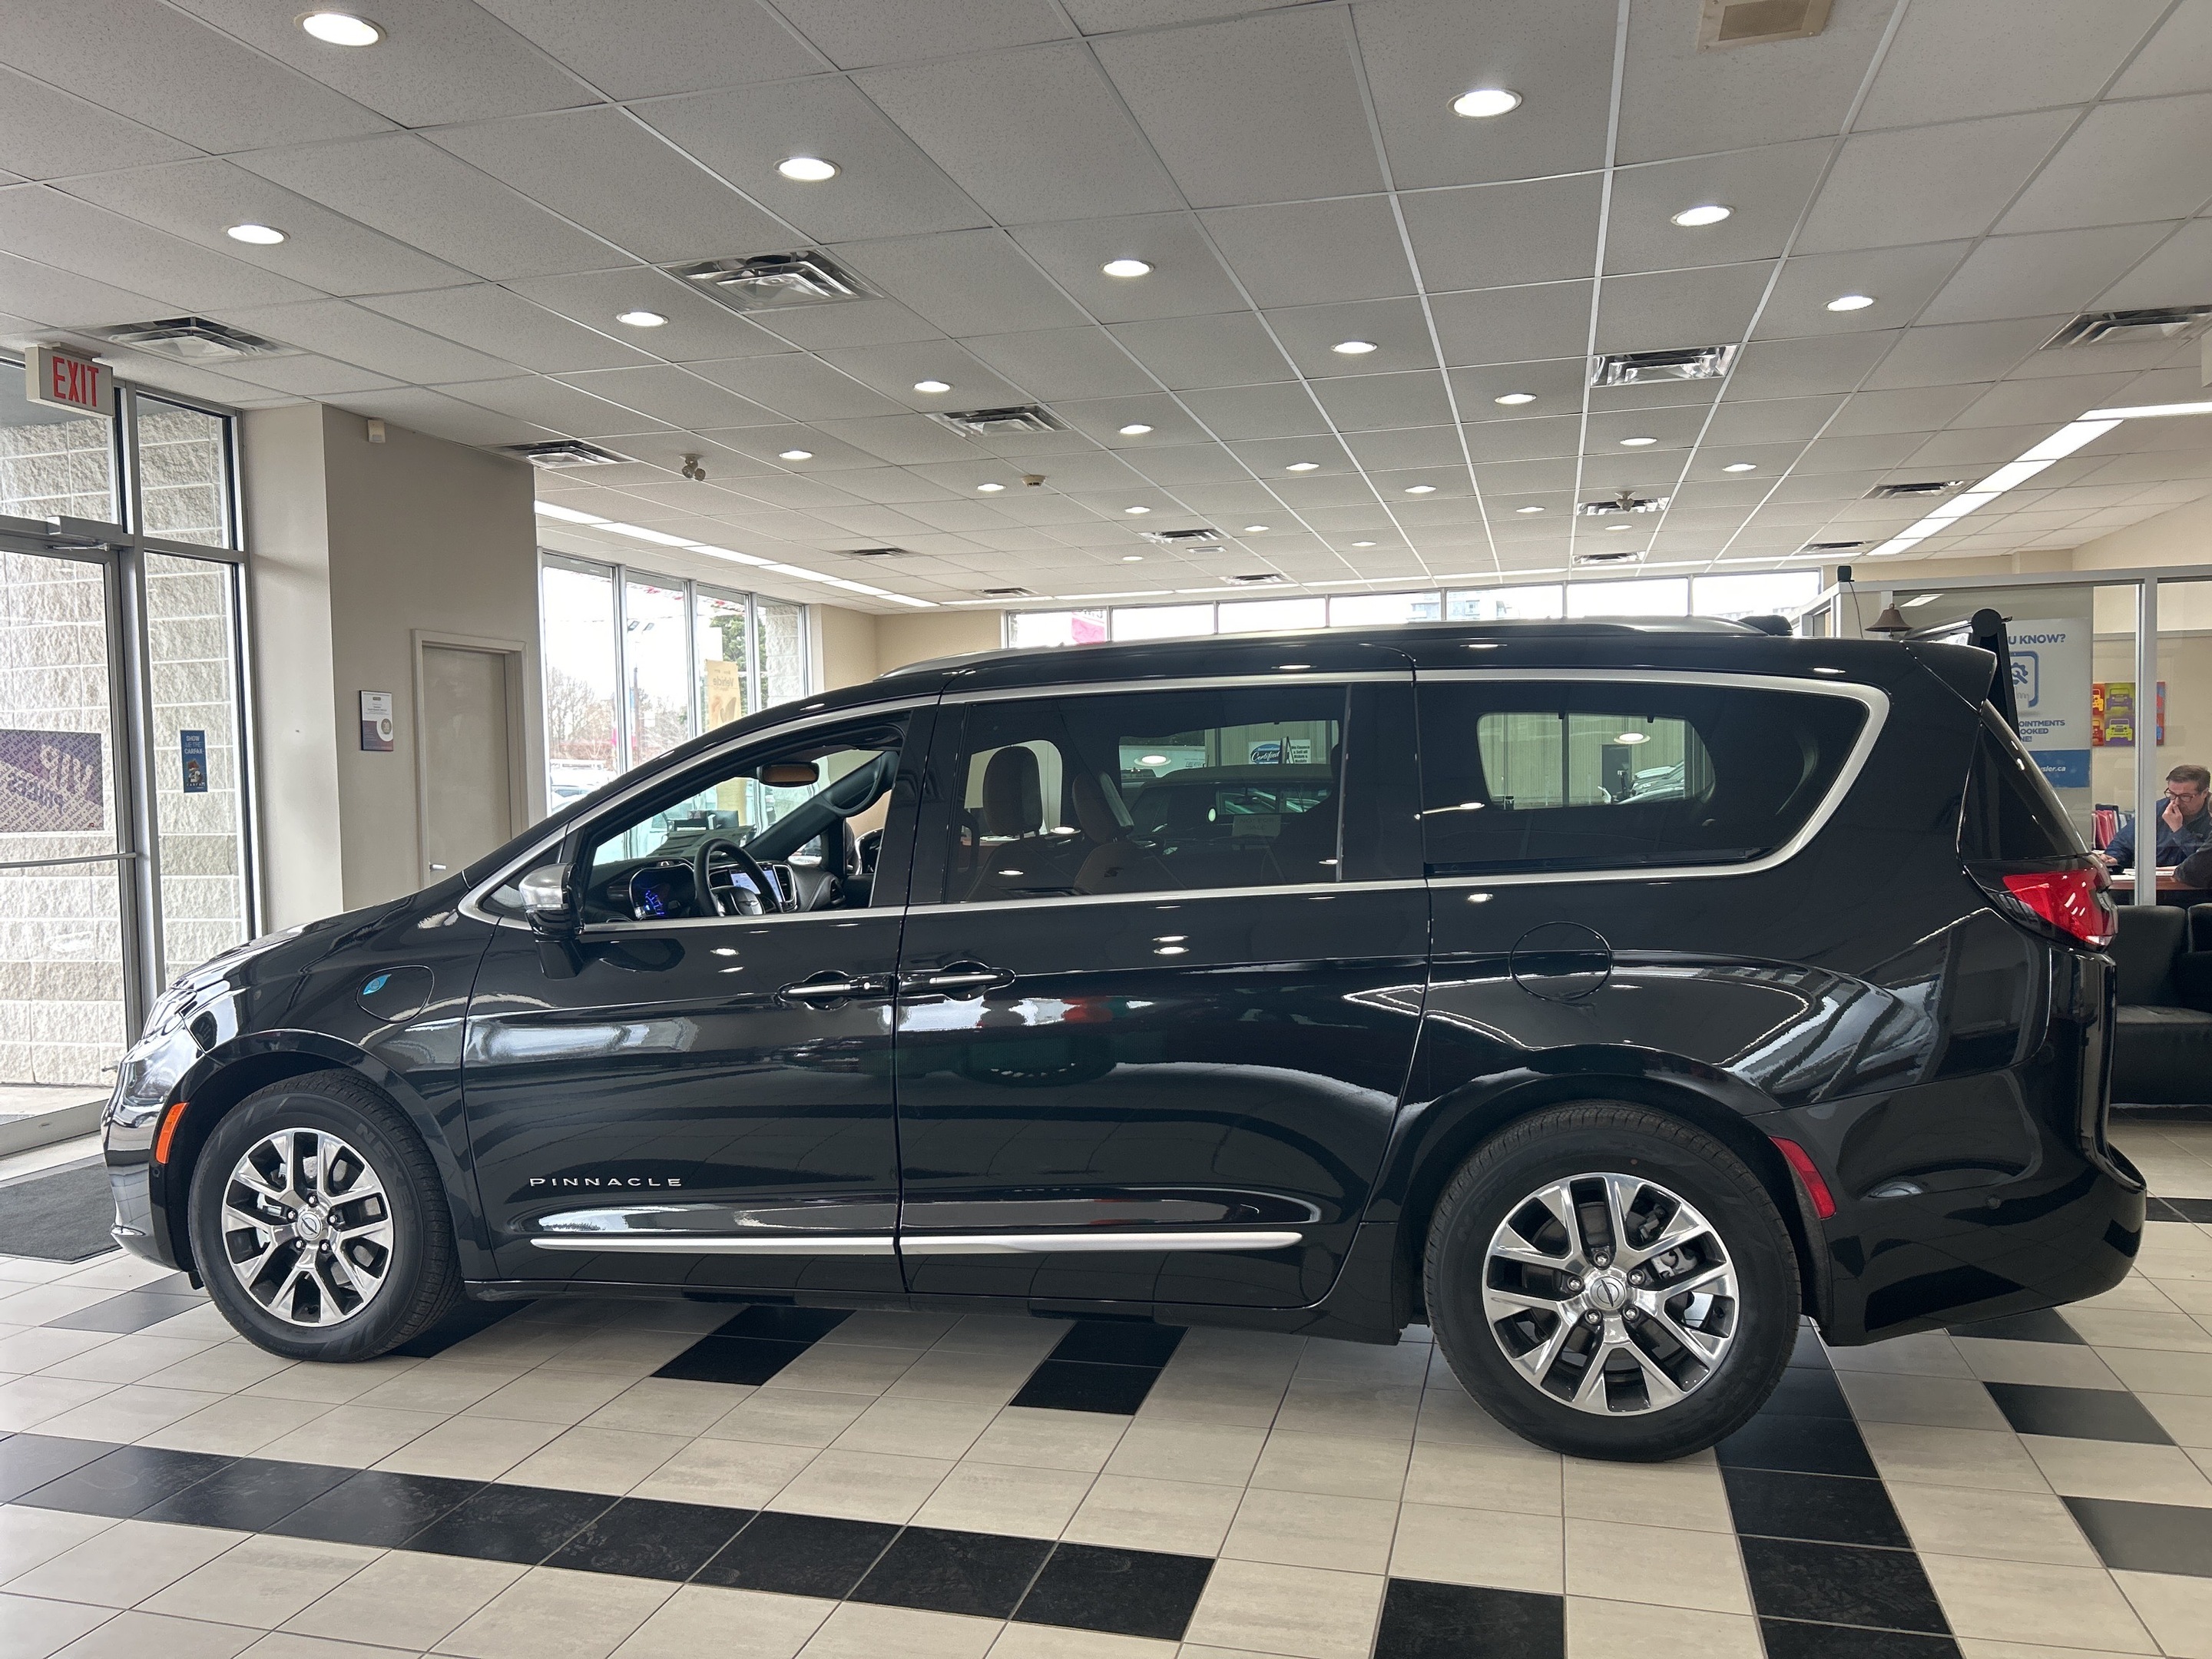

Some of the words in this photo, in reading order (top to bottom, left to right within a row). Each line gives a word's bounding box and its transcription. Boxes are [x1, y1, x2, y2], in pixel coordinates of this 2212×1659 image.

[52, 356, 99, 407] EXIT
[2019, 634, 2066, 644] KNOW?
[2018, 719, 2065, 727] OINTMENTS
[1251, 750, 1280, 762] Certified
[529, 1177, 682, 1187] PINNACLE
